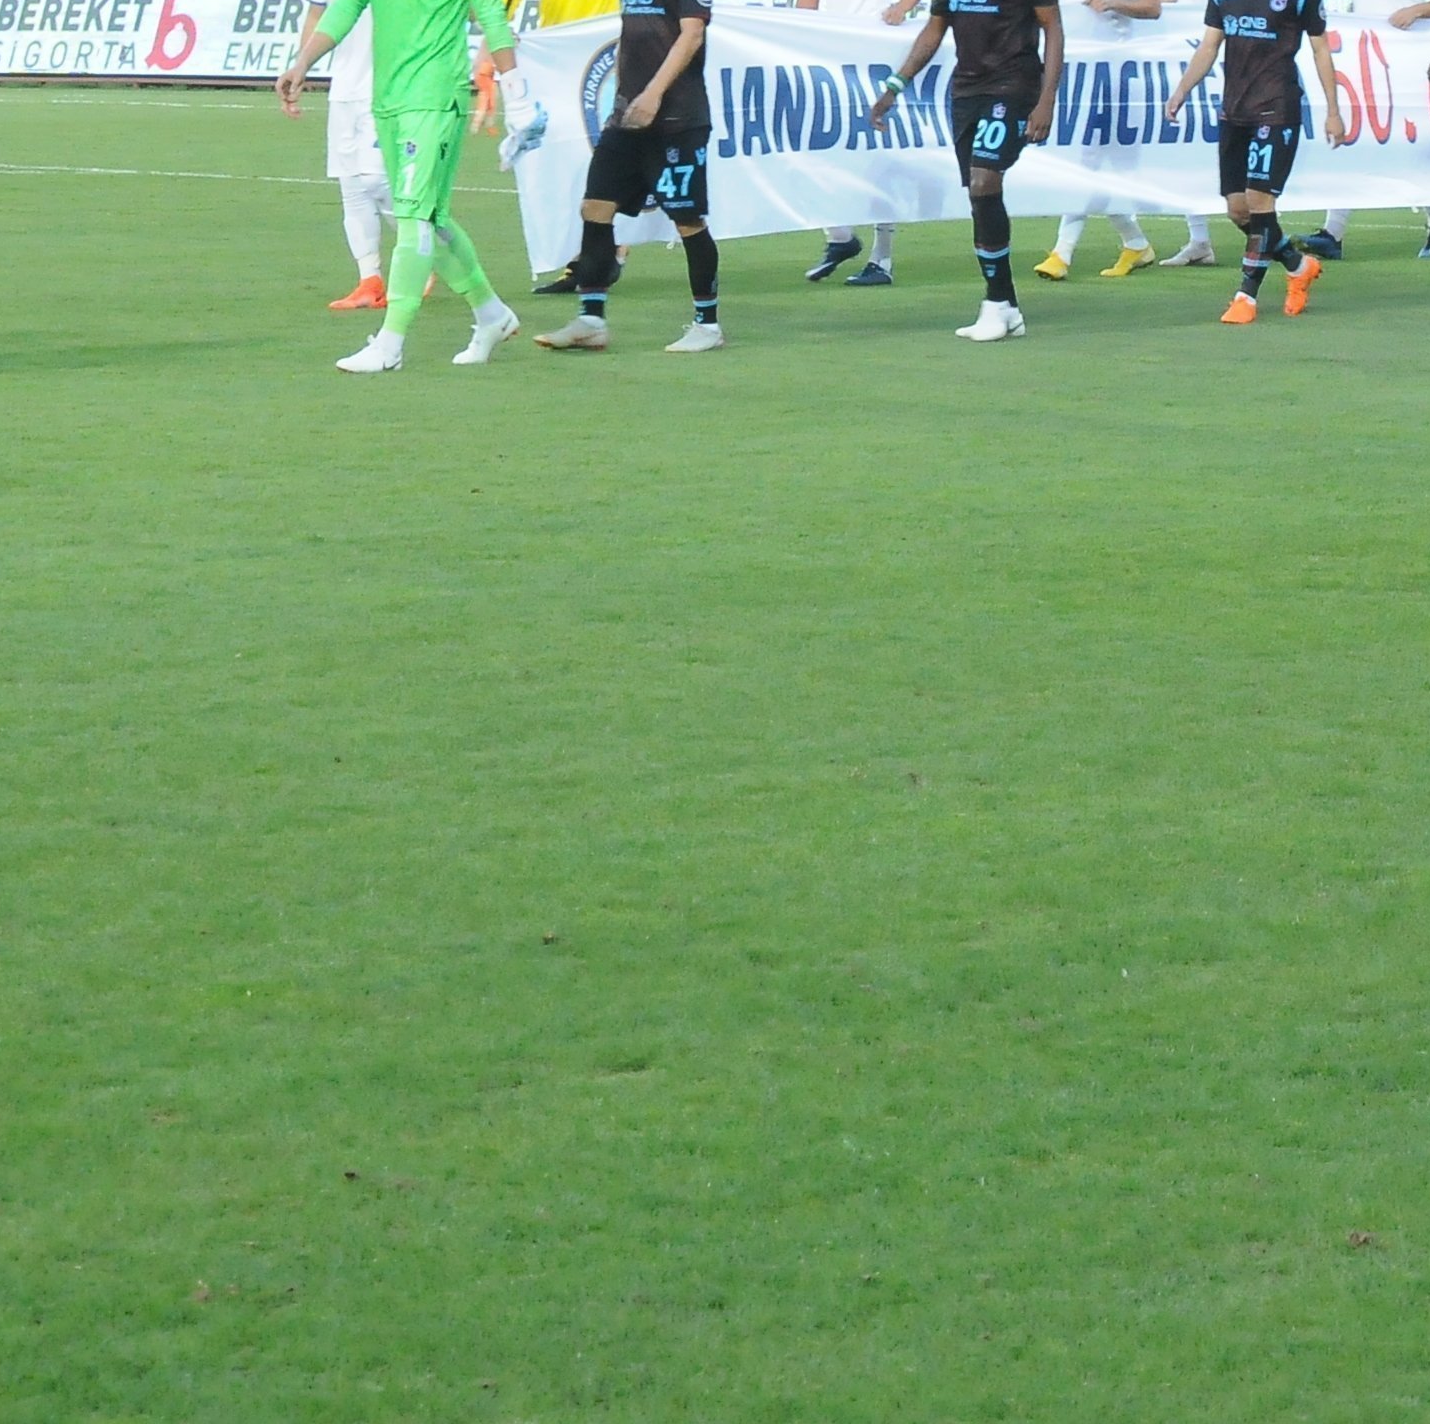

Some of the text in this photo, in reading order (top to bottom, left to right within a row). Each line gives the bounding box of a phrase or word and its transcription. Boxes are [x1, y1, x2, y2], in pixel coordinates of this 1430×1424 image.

[1238, 16, 1267, 30] QNB
[718, 63, 954, 159] JANDARM
[973, 119, 1007, 150] 20
[1248, 141, 1273, 173] 61
[401, 162, 416, 195] 1
[656, 165, 695, 199] 47
